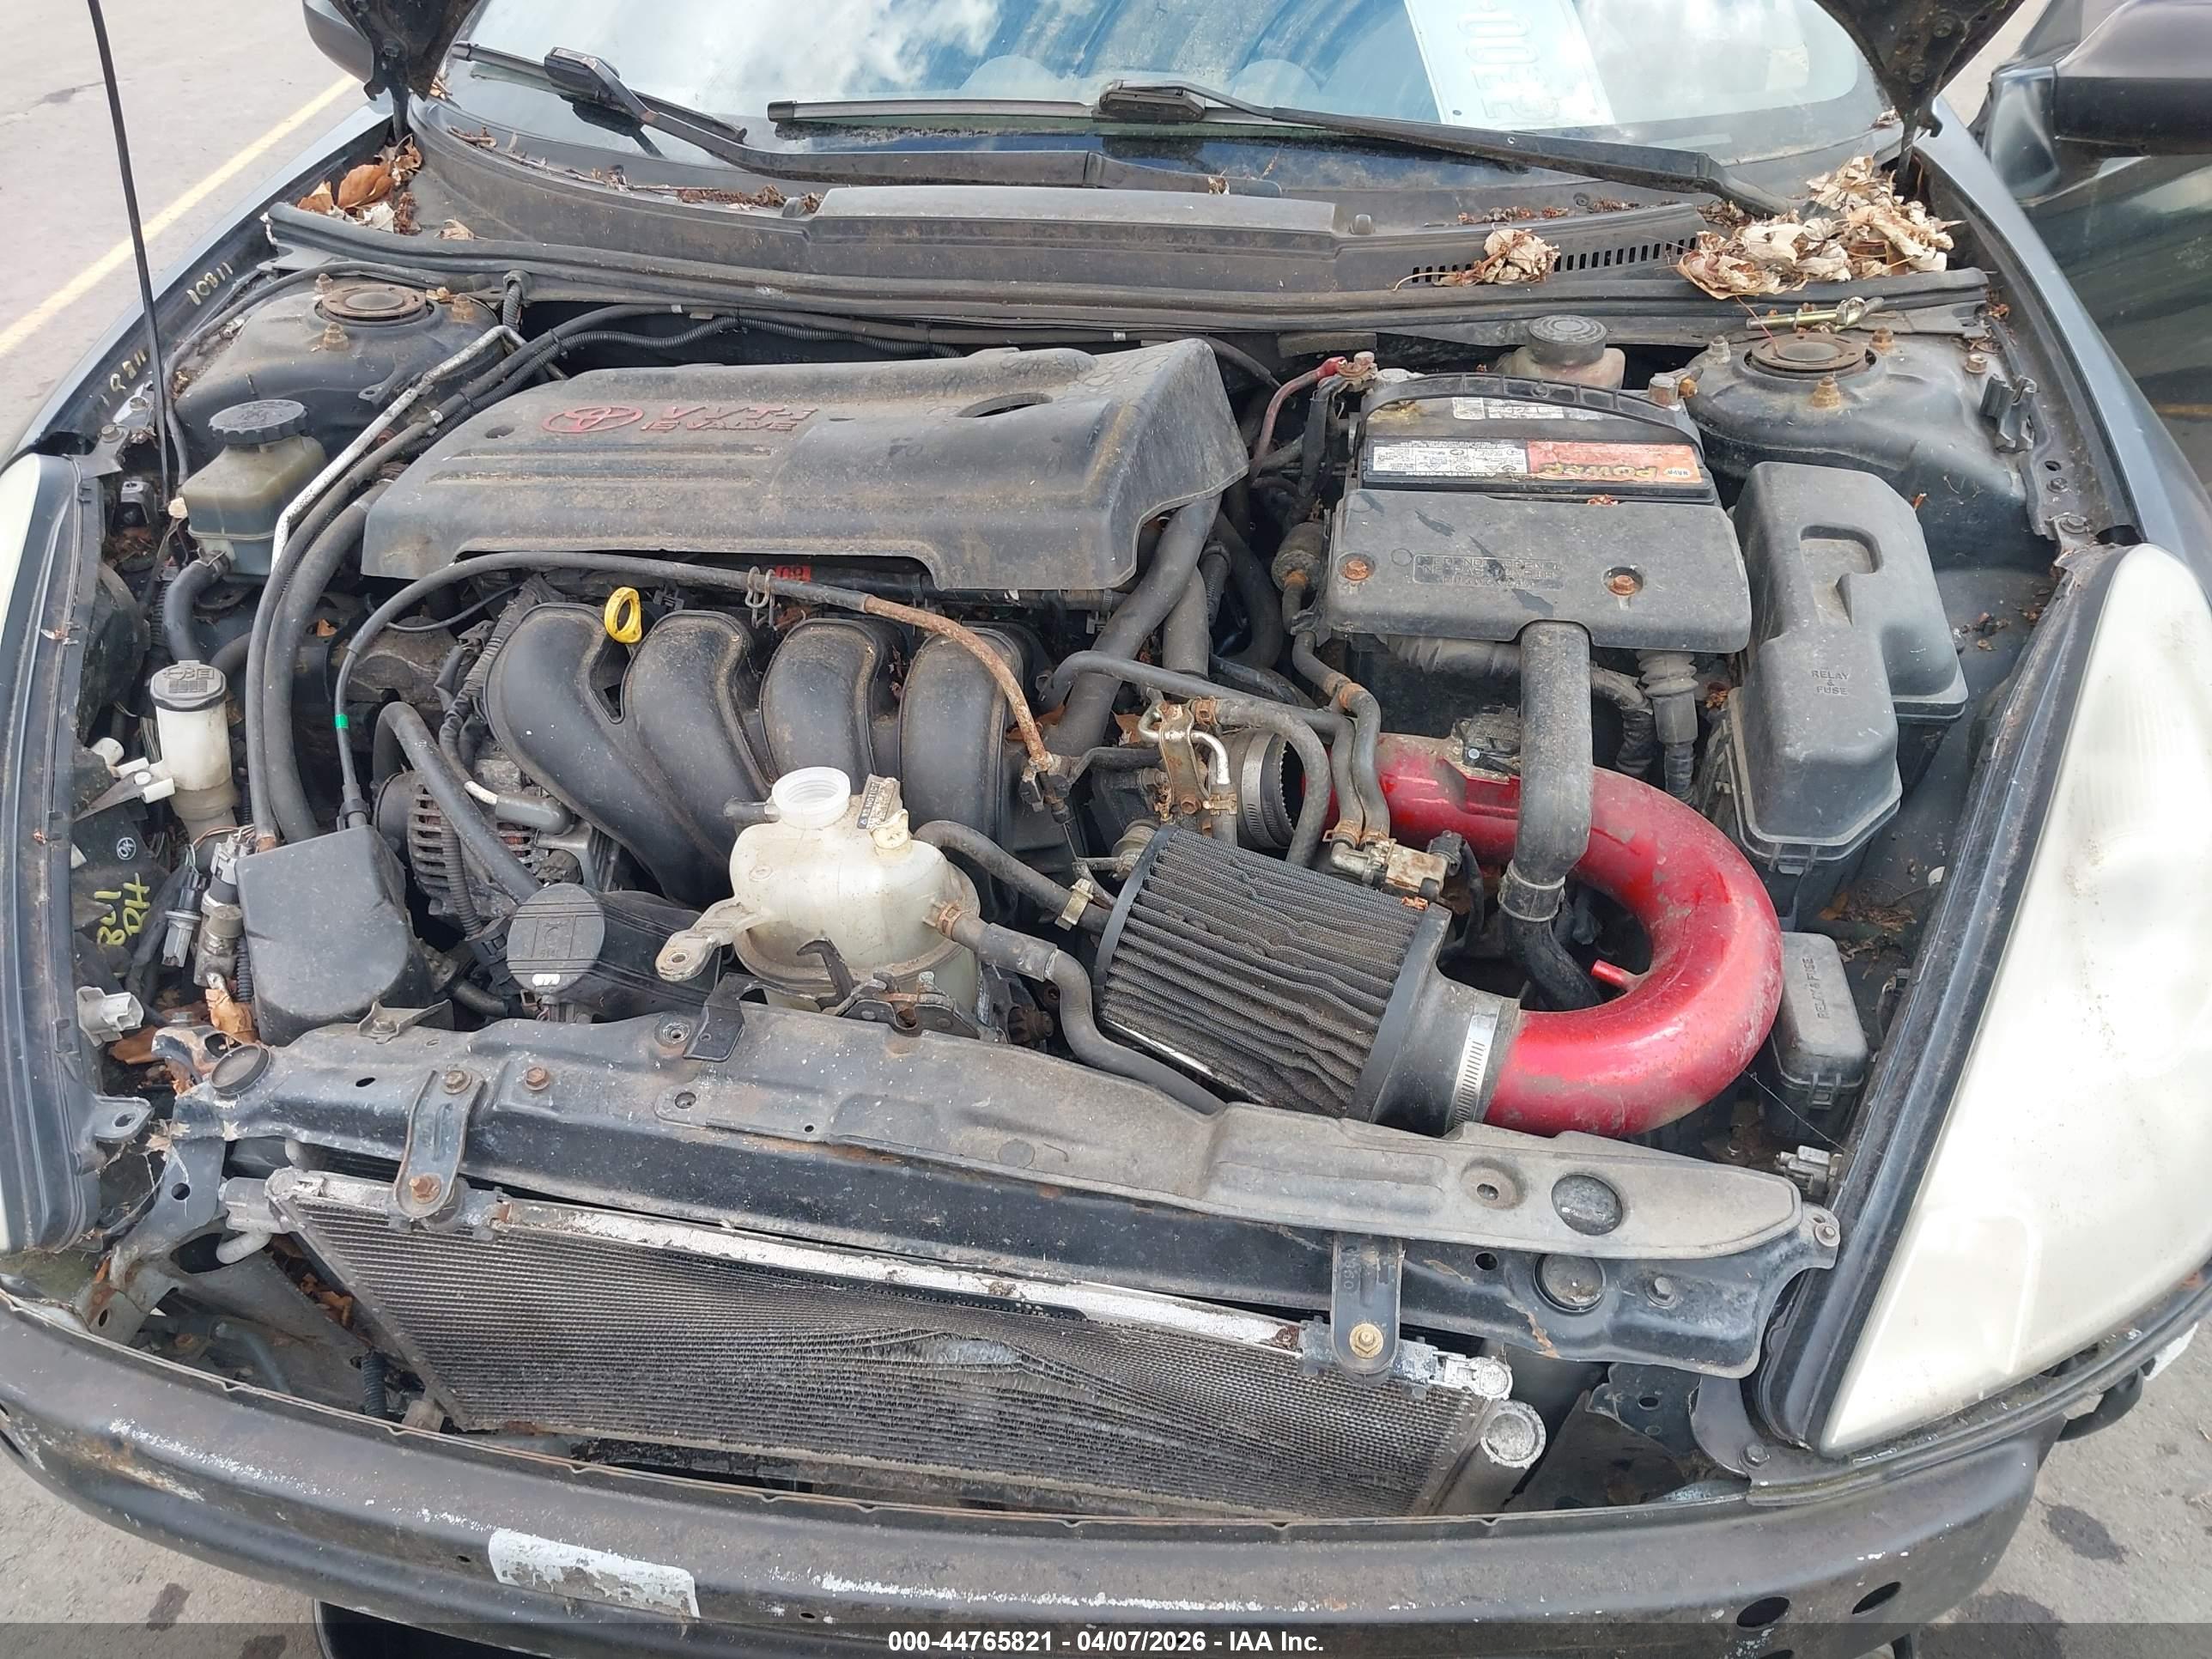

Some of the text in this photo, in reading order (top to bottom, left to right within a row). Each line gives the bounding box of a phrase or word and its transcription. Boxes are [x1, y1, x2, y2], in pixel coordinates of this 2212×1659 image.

[1811, 670, 1849, 680] RELAY
[1816, 686, 1848, 696] FUSE
[118, 839, 135, 858] OK
[1802, 957, 1820, 981] FUSE
